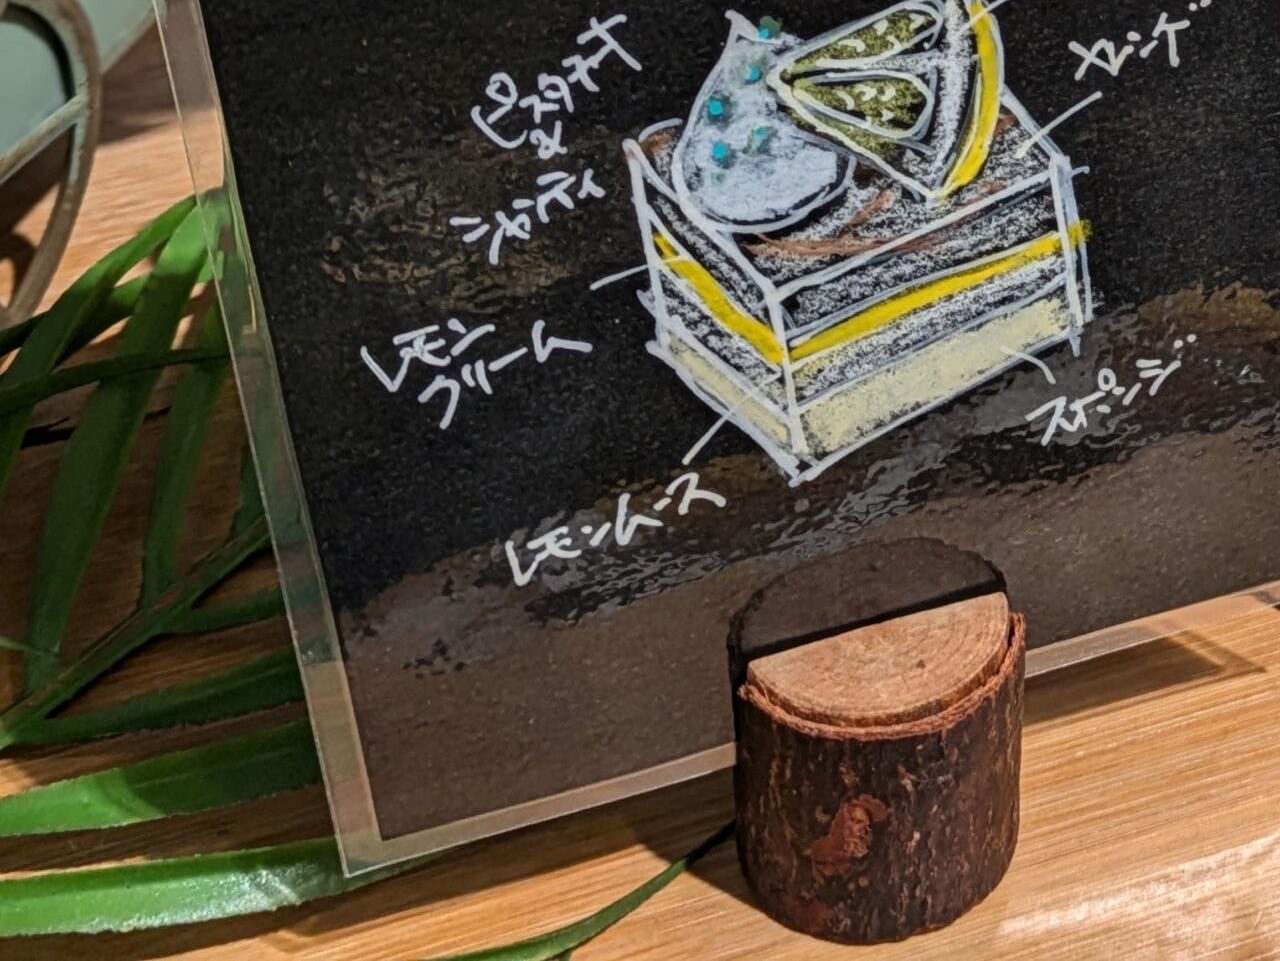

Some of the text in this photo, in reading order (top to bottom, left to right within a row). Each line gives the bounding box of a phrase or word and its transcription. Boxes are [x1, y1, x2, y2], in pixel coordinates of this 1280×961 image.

[360, 318, 497, 393] レモン
[417, 319, 594, 430] クリーム
[1024, 333, 1197, 447] スポンジ
[504, 472, 727, 587] レモンムース
